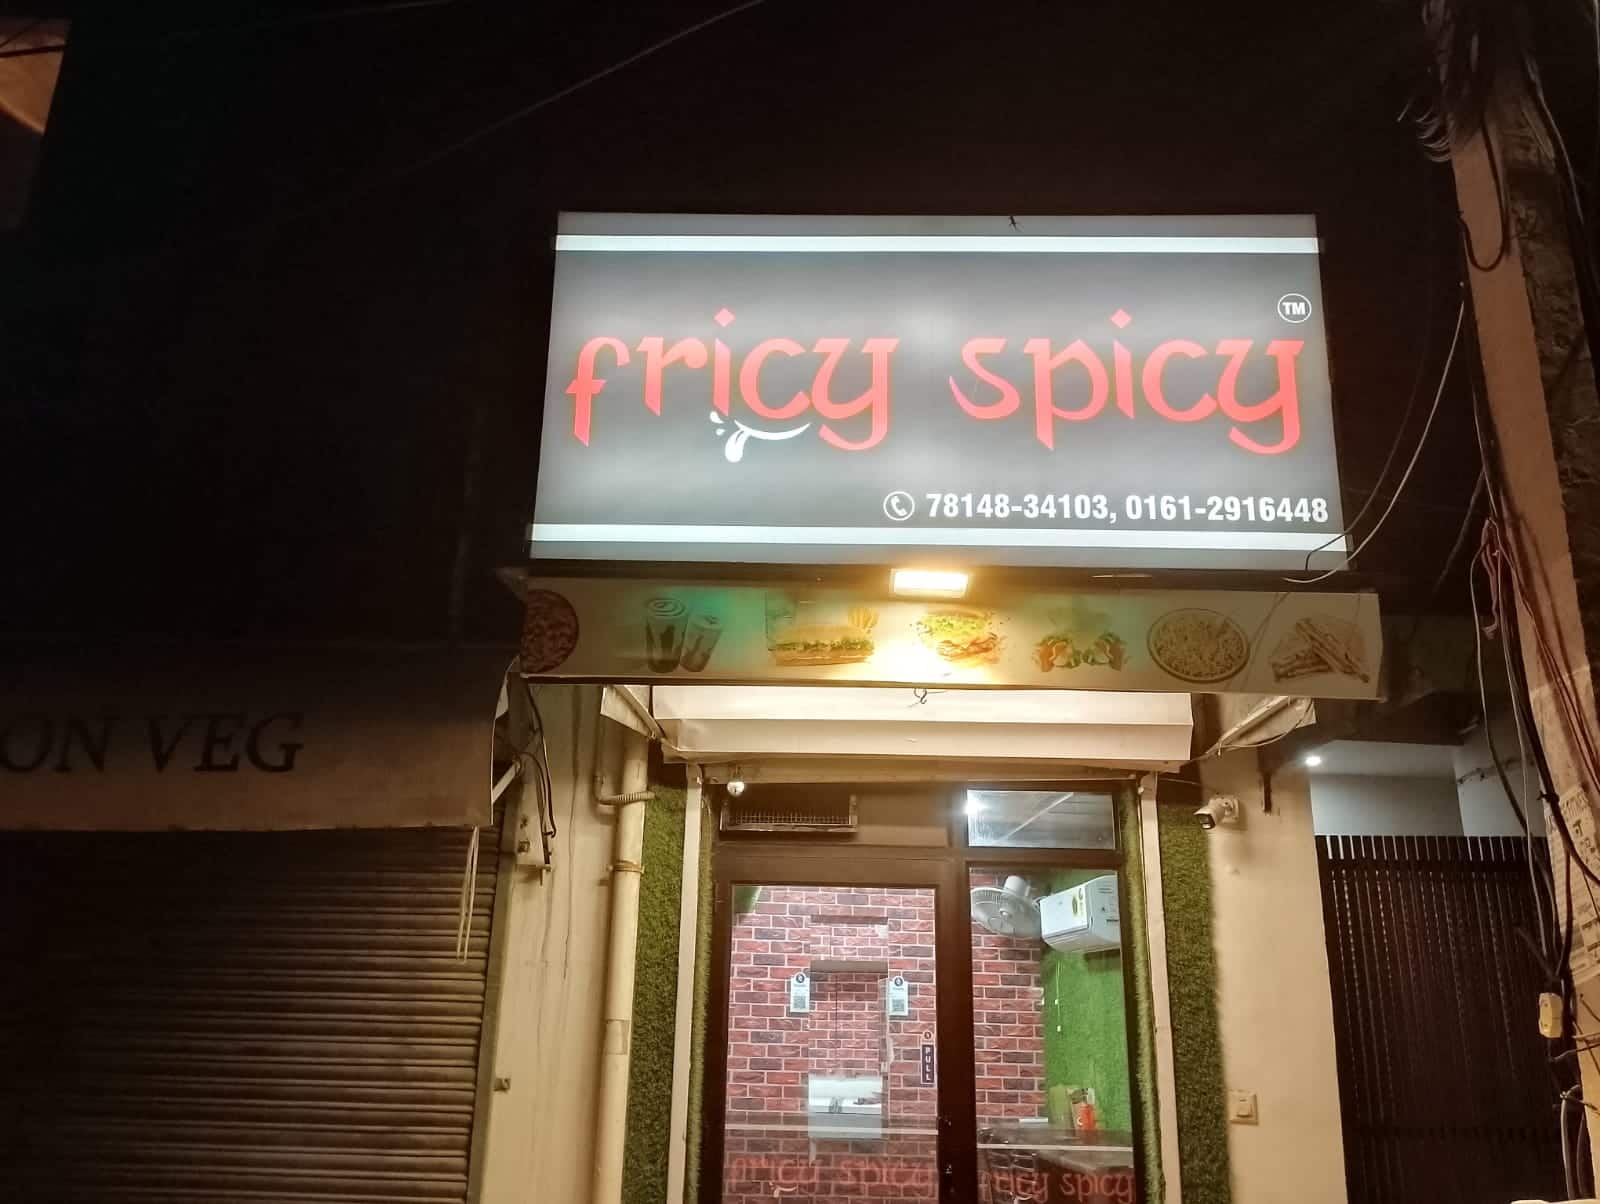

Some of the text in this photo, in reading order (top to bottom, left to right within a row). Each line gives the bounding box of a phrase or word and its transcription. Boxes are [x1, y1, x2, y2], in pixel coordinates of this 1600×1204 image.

[1282, 302, 1306, 315] TM
[566, 307, 1304, 455] fricy spicy
[925, 492, 1329, 524] 78148-34103, 0161-2916448
[147, 711, 304, 773] VEG
